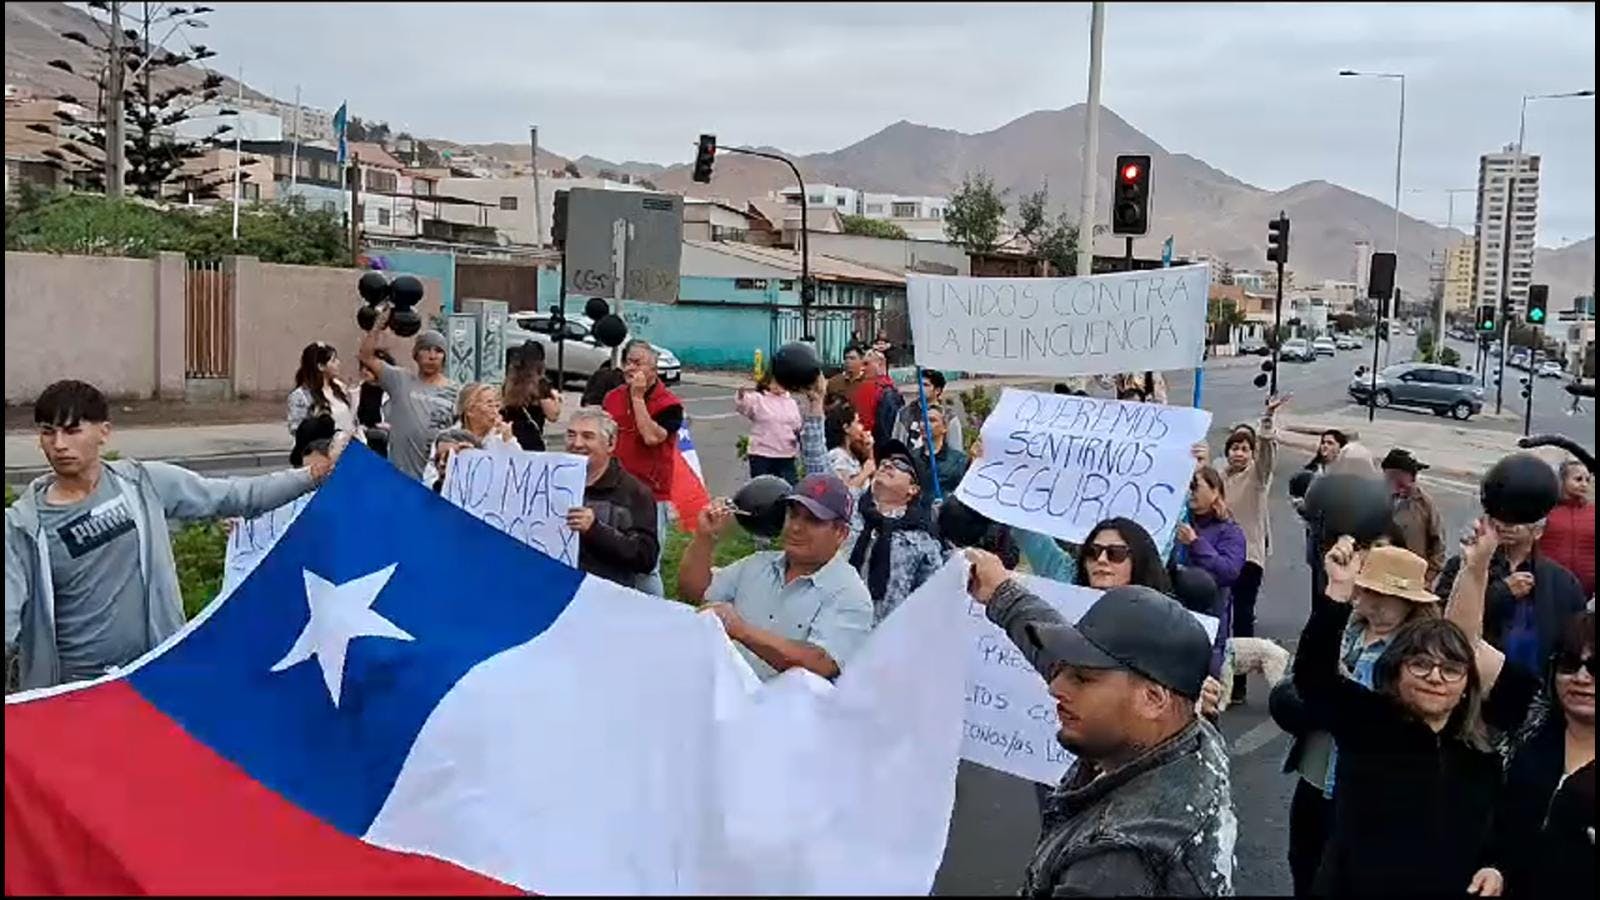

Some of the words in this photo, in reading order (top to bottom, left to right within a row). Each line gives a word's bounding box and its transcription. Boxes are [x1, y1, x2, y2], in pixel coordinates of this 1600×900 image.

[926, 281, 1039, 319] UNIDOS
[1052, 275, 1190, 316] CONTRA
[926, 325, 961, 355] LA
[971, 313, 1179, 361] DELINCUENCIA
[1015, 394, 1170, 440] QUEREMOS
[1004, 430, 1158, 477] SENTIRNOS
[448, 455, 494, 509] NO
[501, 457, 580, 519] MAS
[962, 462, 1176, 536] SEGUROS
[558, 524, 575, 568] X
